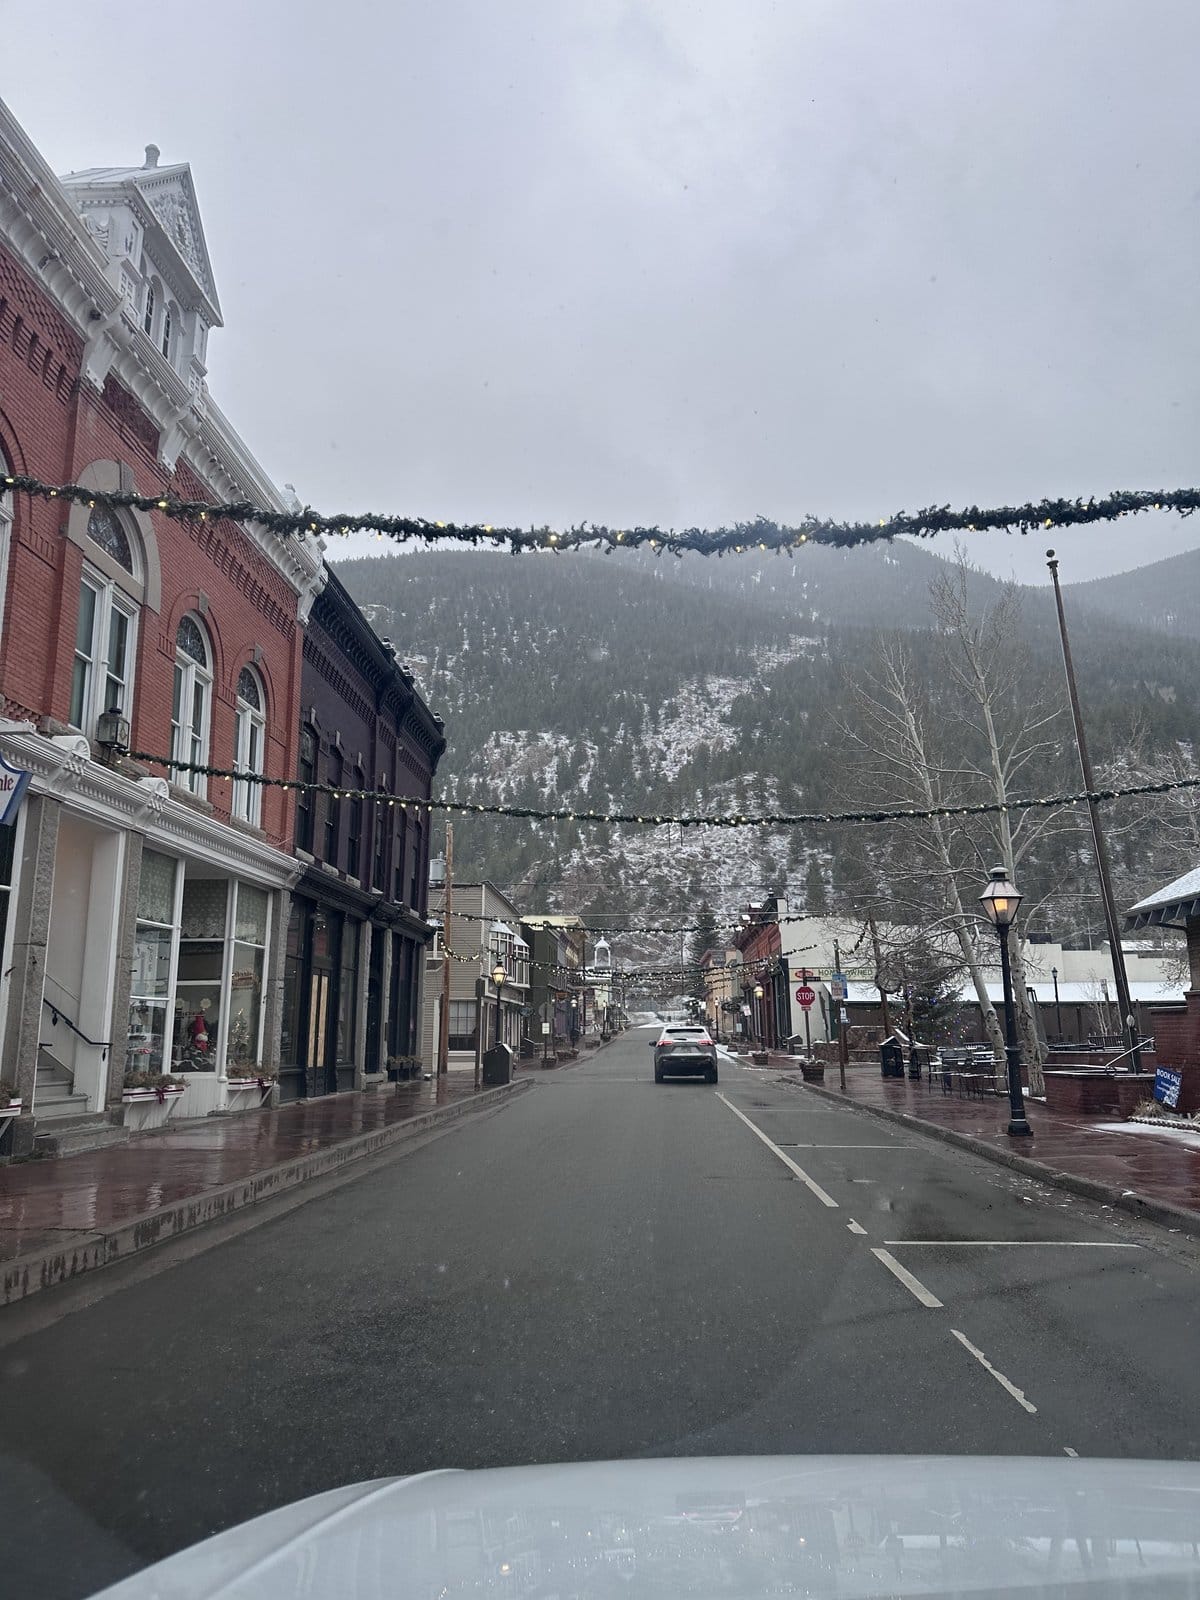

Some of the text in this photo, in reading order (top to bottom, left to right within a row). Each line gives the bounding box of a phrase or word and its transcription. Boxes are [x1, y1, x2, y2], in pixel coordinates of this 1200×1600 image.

[845, 968, 873, 976] OWNED
[797, 992, 814, 1000] STOP
[1156, 1068, 1171, 1080] BOOK
[1170, 1074, 1181, 1085] SALE
